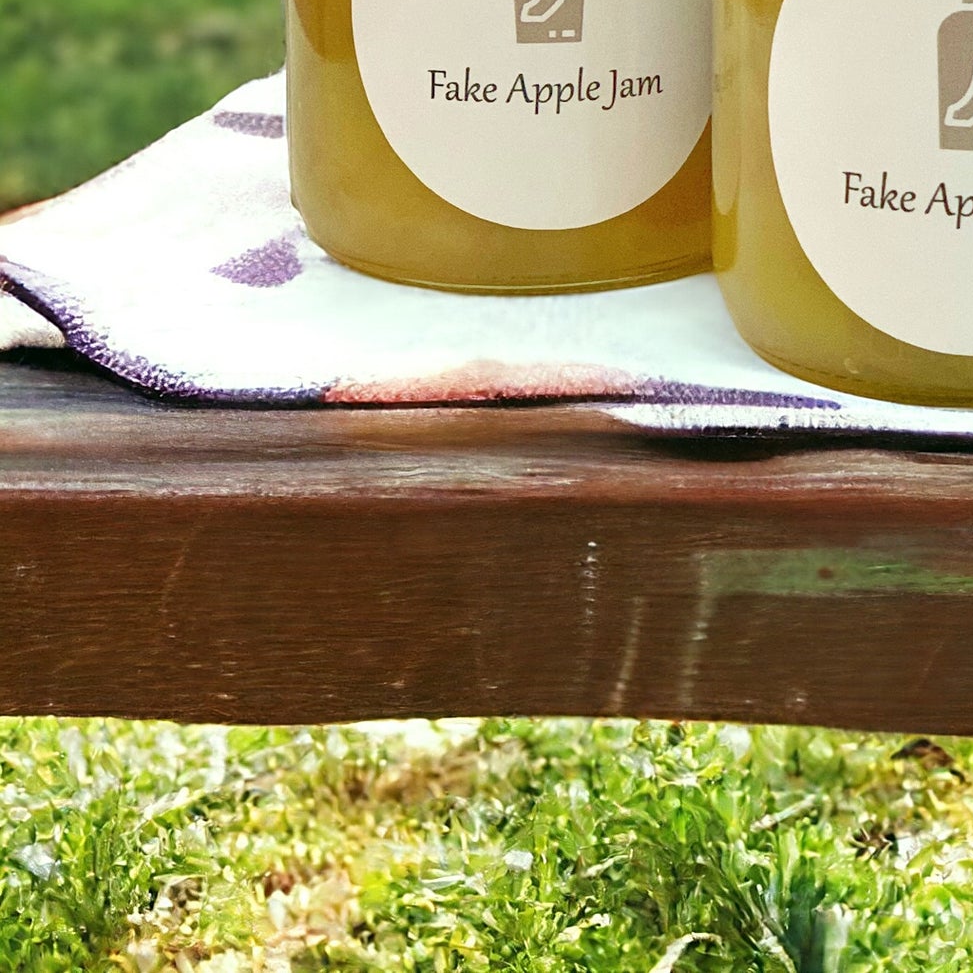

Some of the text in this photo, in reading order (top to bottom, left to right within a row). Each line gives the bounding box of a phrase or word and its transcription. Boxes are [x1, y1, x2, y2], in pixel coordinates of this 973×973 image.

[427, 66, 664, 115] Fake Apple Jam
[841, 170, 917, 213] Fake
